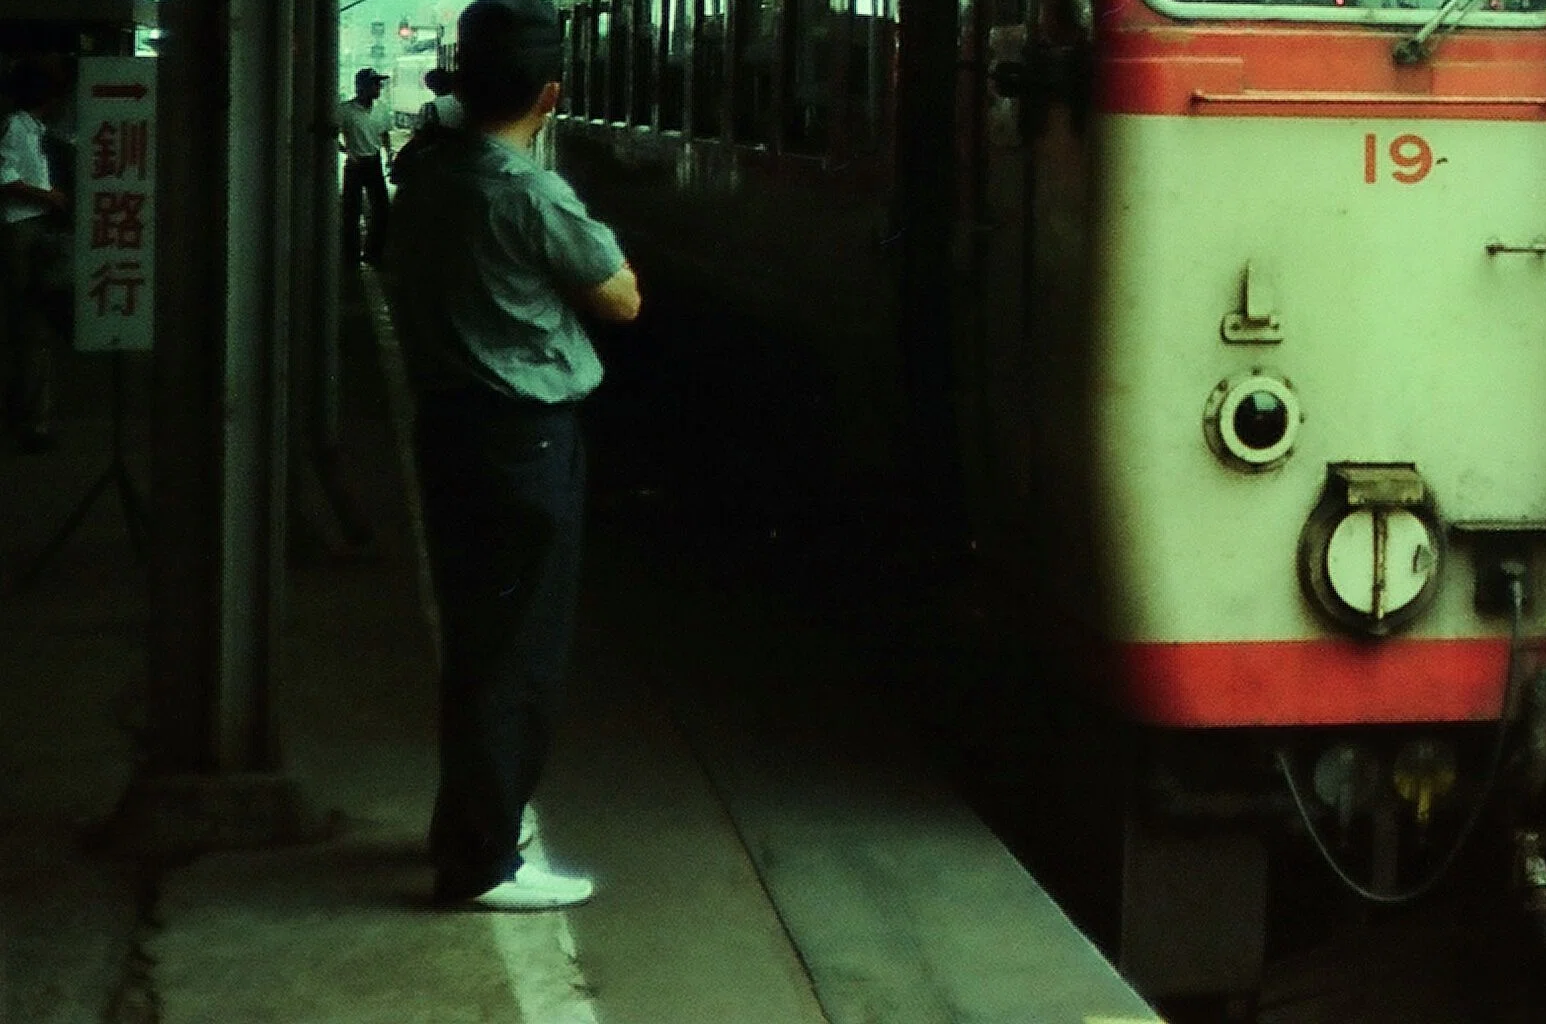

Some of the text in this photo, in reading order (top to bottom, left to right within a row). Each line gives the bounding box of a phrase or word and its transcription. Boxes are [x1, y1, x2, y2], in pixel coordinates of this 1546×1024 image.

[90, 119, 149, 318] 釧路行
[1364, 132, 1434, 185] 19
